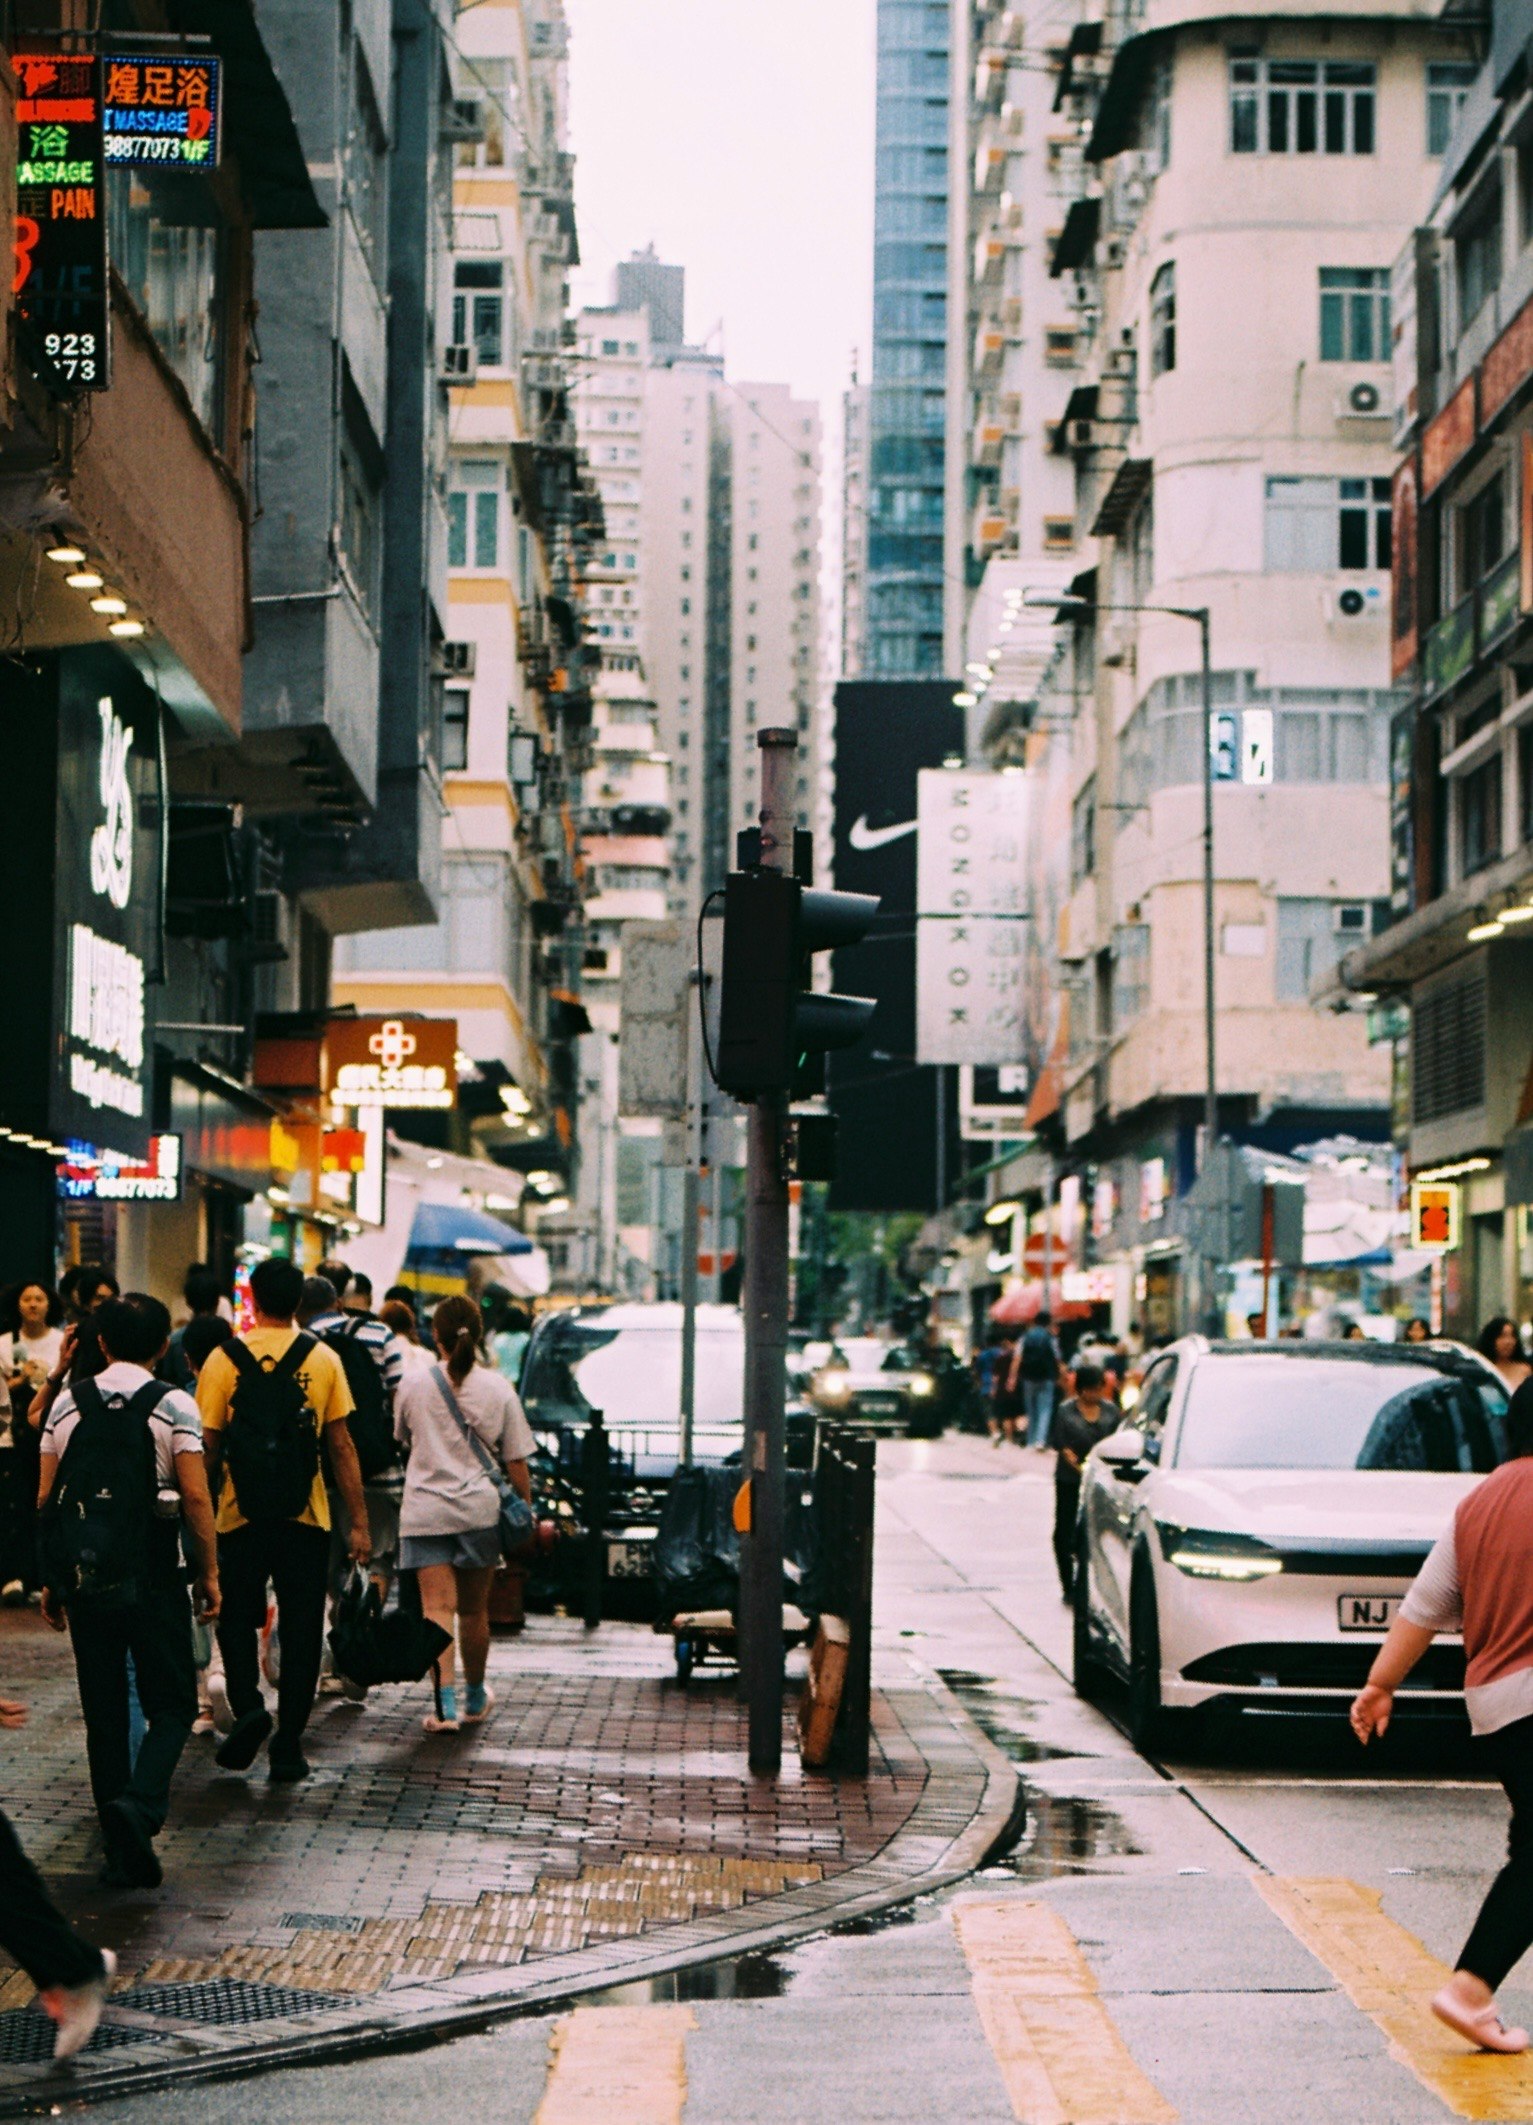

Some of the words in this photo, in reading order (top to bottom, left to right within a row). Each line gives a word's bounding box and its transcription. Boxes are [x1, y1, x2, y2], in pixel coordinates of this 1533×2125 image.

[114, 109, 188, 132] MASSAGE
[30, 125, 69, 158] 浴
[51, 189, 95, 219] PAIN
[1352, 1600, 1388, 1623] NJ
